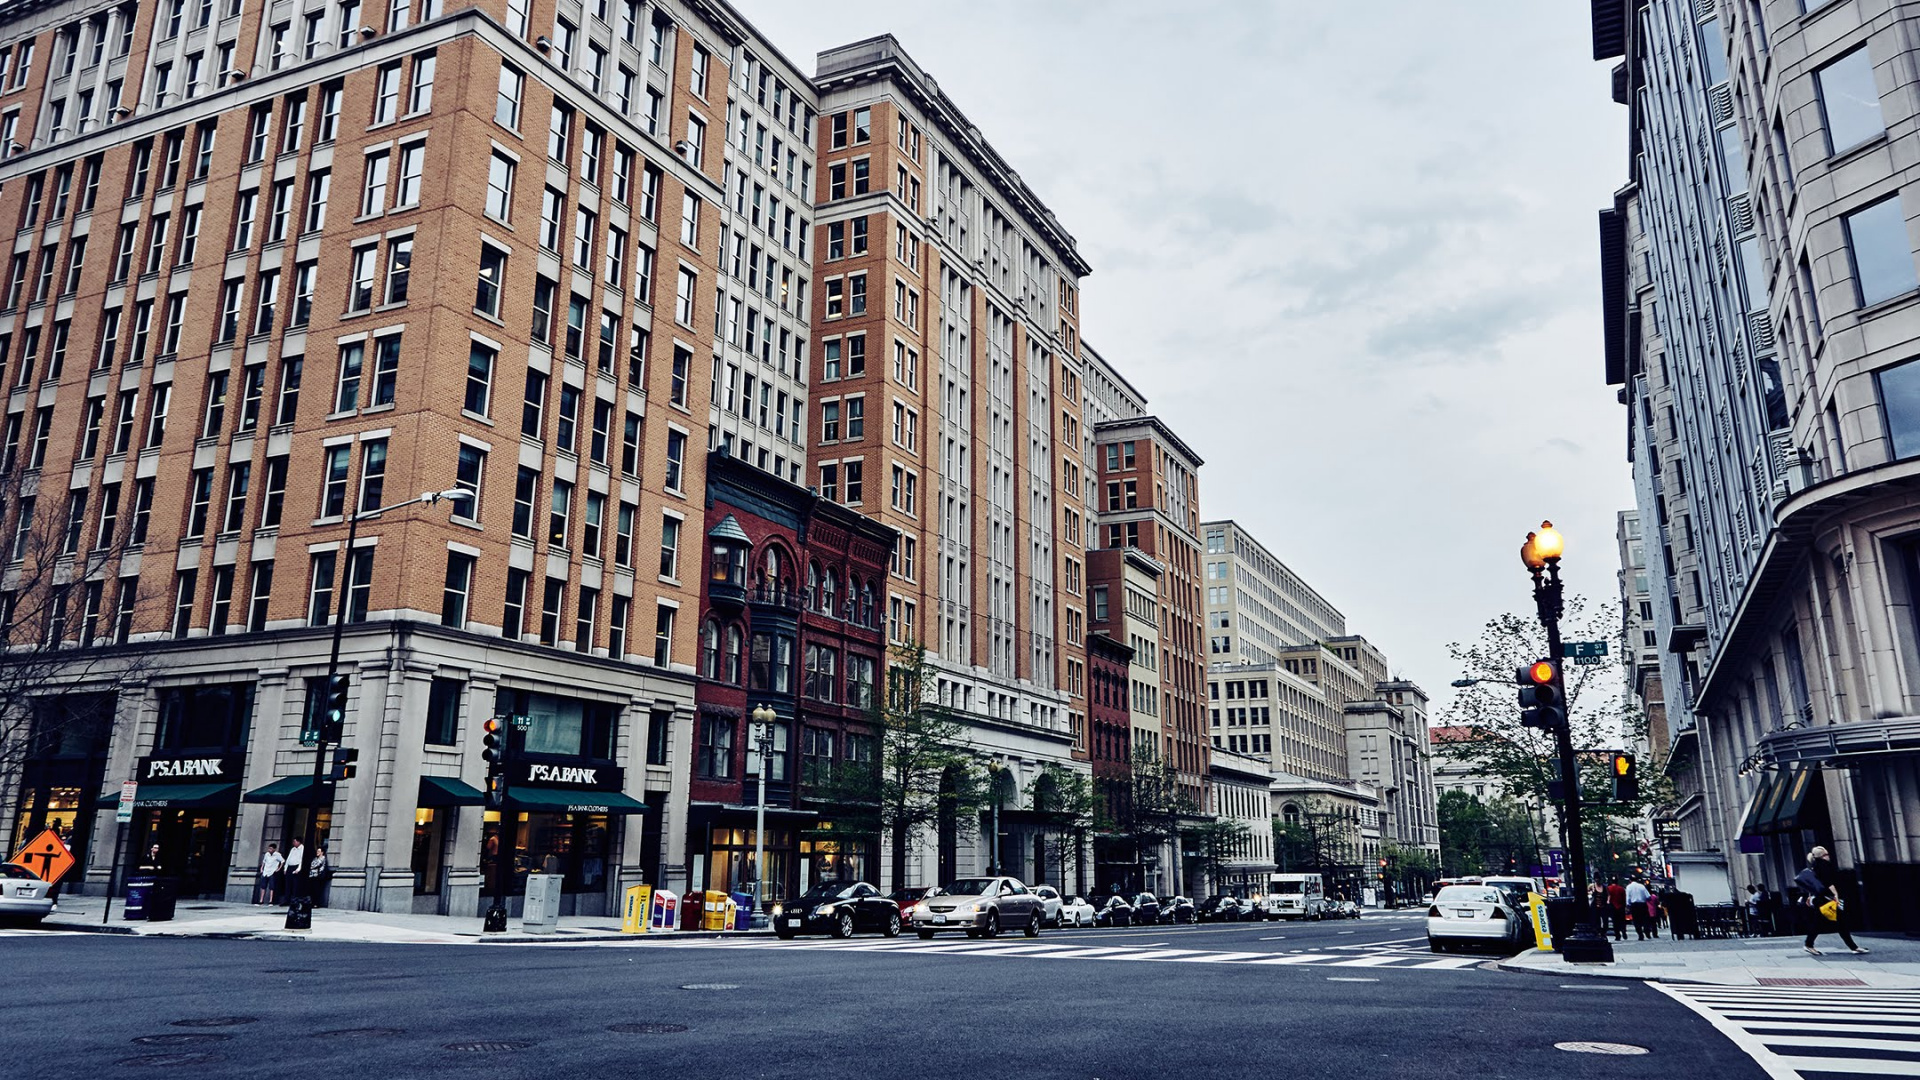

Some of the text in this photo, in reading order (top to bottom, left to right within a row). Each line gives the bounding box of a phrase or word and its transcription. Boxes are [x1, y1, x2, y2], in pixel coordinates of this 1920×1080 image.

[1575, 644, 1584, 656] F
[1575, 656, 1599, 665] 1100
[304, 731, 310, 740] F
[1537, 905, 1547, 933] express
